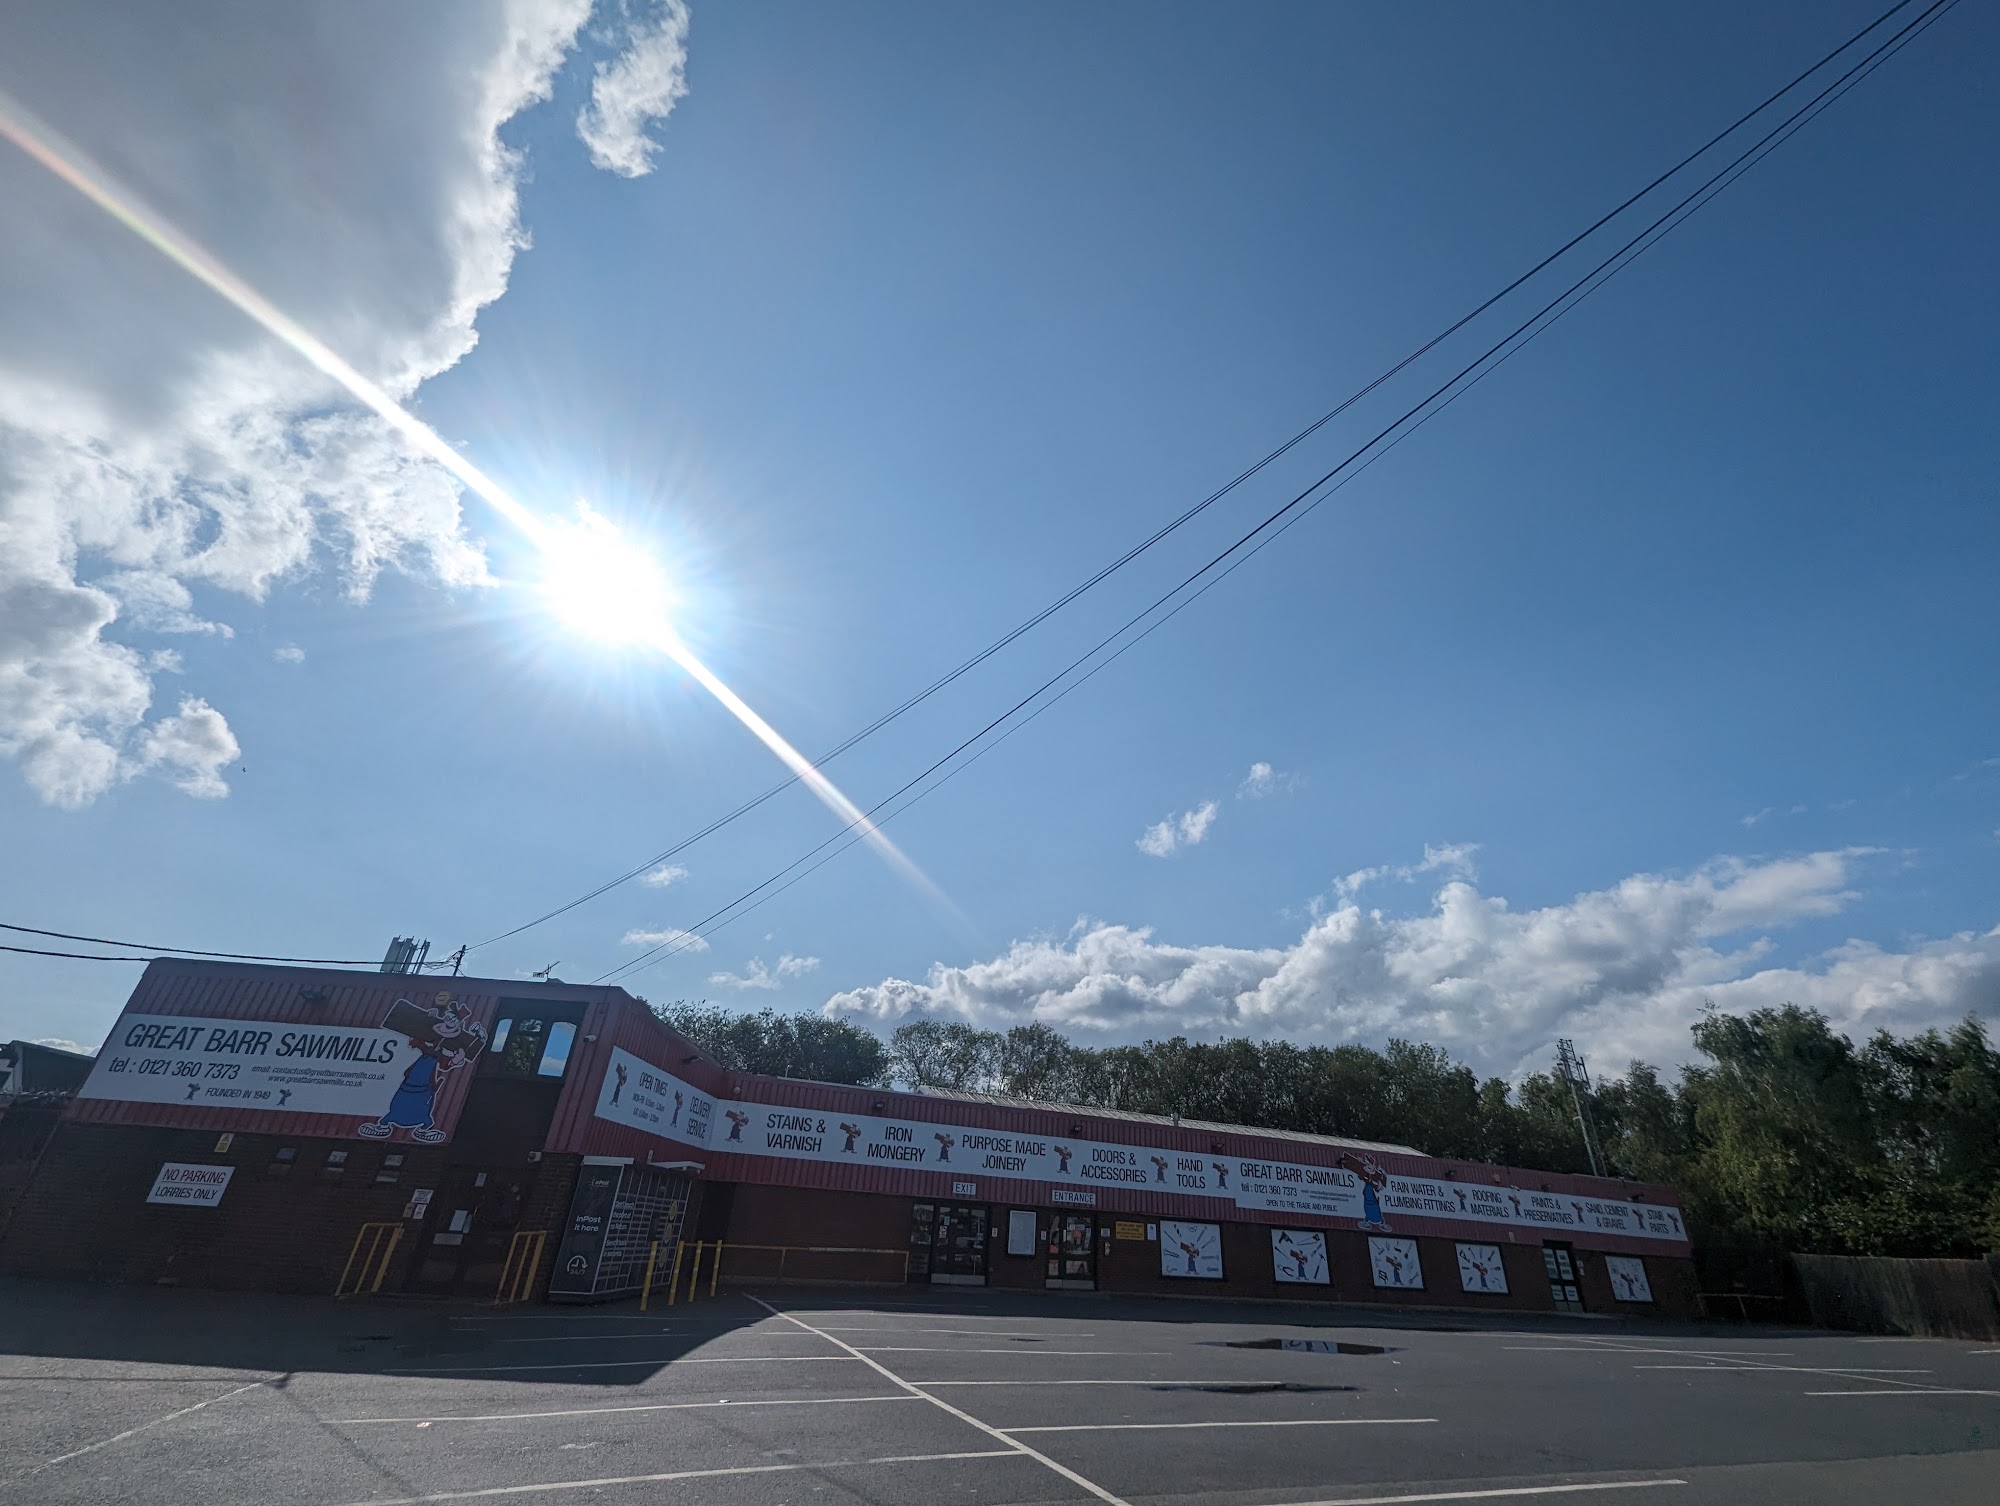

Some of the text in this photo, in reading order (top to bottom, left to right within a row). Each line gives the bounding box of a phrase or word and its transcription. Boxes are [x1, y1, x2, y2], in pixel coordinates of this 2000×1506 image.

[124, 1024, 398, 1063] GREAT BARR SAWMILLS
[109, 1057, 130, 1072] tel
[138, 1059, 172, 1075] 0121
[172, 1061, 202, 1077] 360
[204, 1063, 241, 1079] 7373
[639, 1072, 668, 1096] OPEN TIMES
[204, 1087, 271, 1100] FOUNDED IN 1949
[689, 1096, 712, 1119] DELIVERY
[686, 1118, 707, 1139] SERVICE
[766, 1113, 826, 1133] STAINS &
[885, 1126, 913, 1143] IRON
[766, 1133, 822, 1152] VARNISH
[962, 1134, 1046, 1156] PURPOSE MADE
[867, 1143, 926, 1162] MONGERY
[1092, 1149, 1136, 1165] DOORS &
[982, 1155, 1027, 1171] JOINERY
[1177, 1158, 1203, 1172] HAND
[162, 1168, 226, 1183] NO PARKING
[1080, 1164, 1147, 1183] ACCESSORIES
[1240, 1162, 1355, 1188] GREAT BARR SAWMILLS
[955, 1183, 974, 1193] EXIT
[1176, 1174, 1206, 1189] TOOLS
[1390, 1180, 1444, 1198] RAIN WATER &
[155, 1186, 218, 1200] LORRIES ONLY
[1054, 1191, 1094, 1203] ENTRANCE
[1254, 1183, 1268, 1194] 0121
[1270, 1185, 1281, 1195] 360
[1282, 1186, 1298, 1197] 7373
[1472, 1189, 1503, 1204] ROOFING
[1266, 1199, 1338, 1212] OPEN TO THE TRADE AND PUBLIC
[1384, 1194, 1456, 1213] PLUMBING FITTINGS
[1470, 1203, 1510, 1218] MATERIALS
[1531, 1196, 1561, 1210] PAINTS &
[1524, 1209, 1575, 1225] PRESERVATIVES
[1603, 1204, 1630, 1218] CEMENT
[1647, 1209, 1665, 1221] STAIR
[576, 1215, 602, 1223] InPost
[1596, 1216, 1627, 1230] & GRAVEL
[574, 1223, 599, 1232] it here
[1650, 1221, 1669, 1234] PARTS
